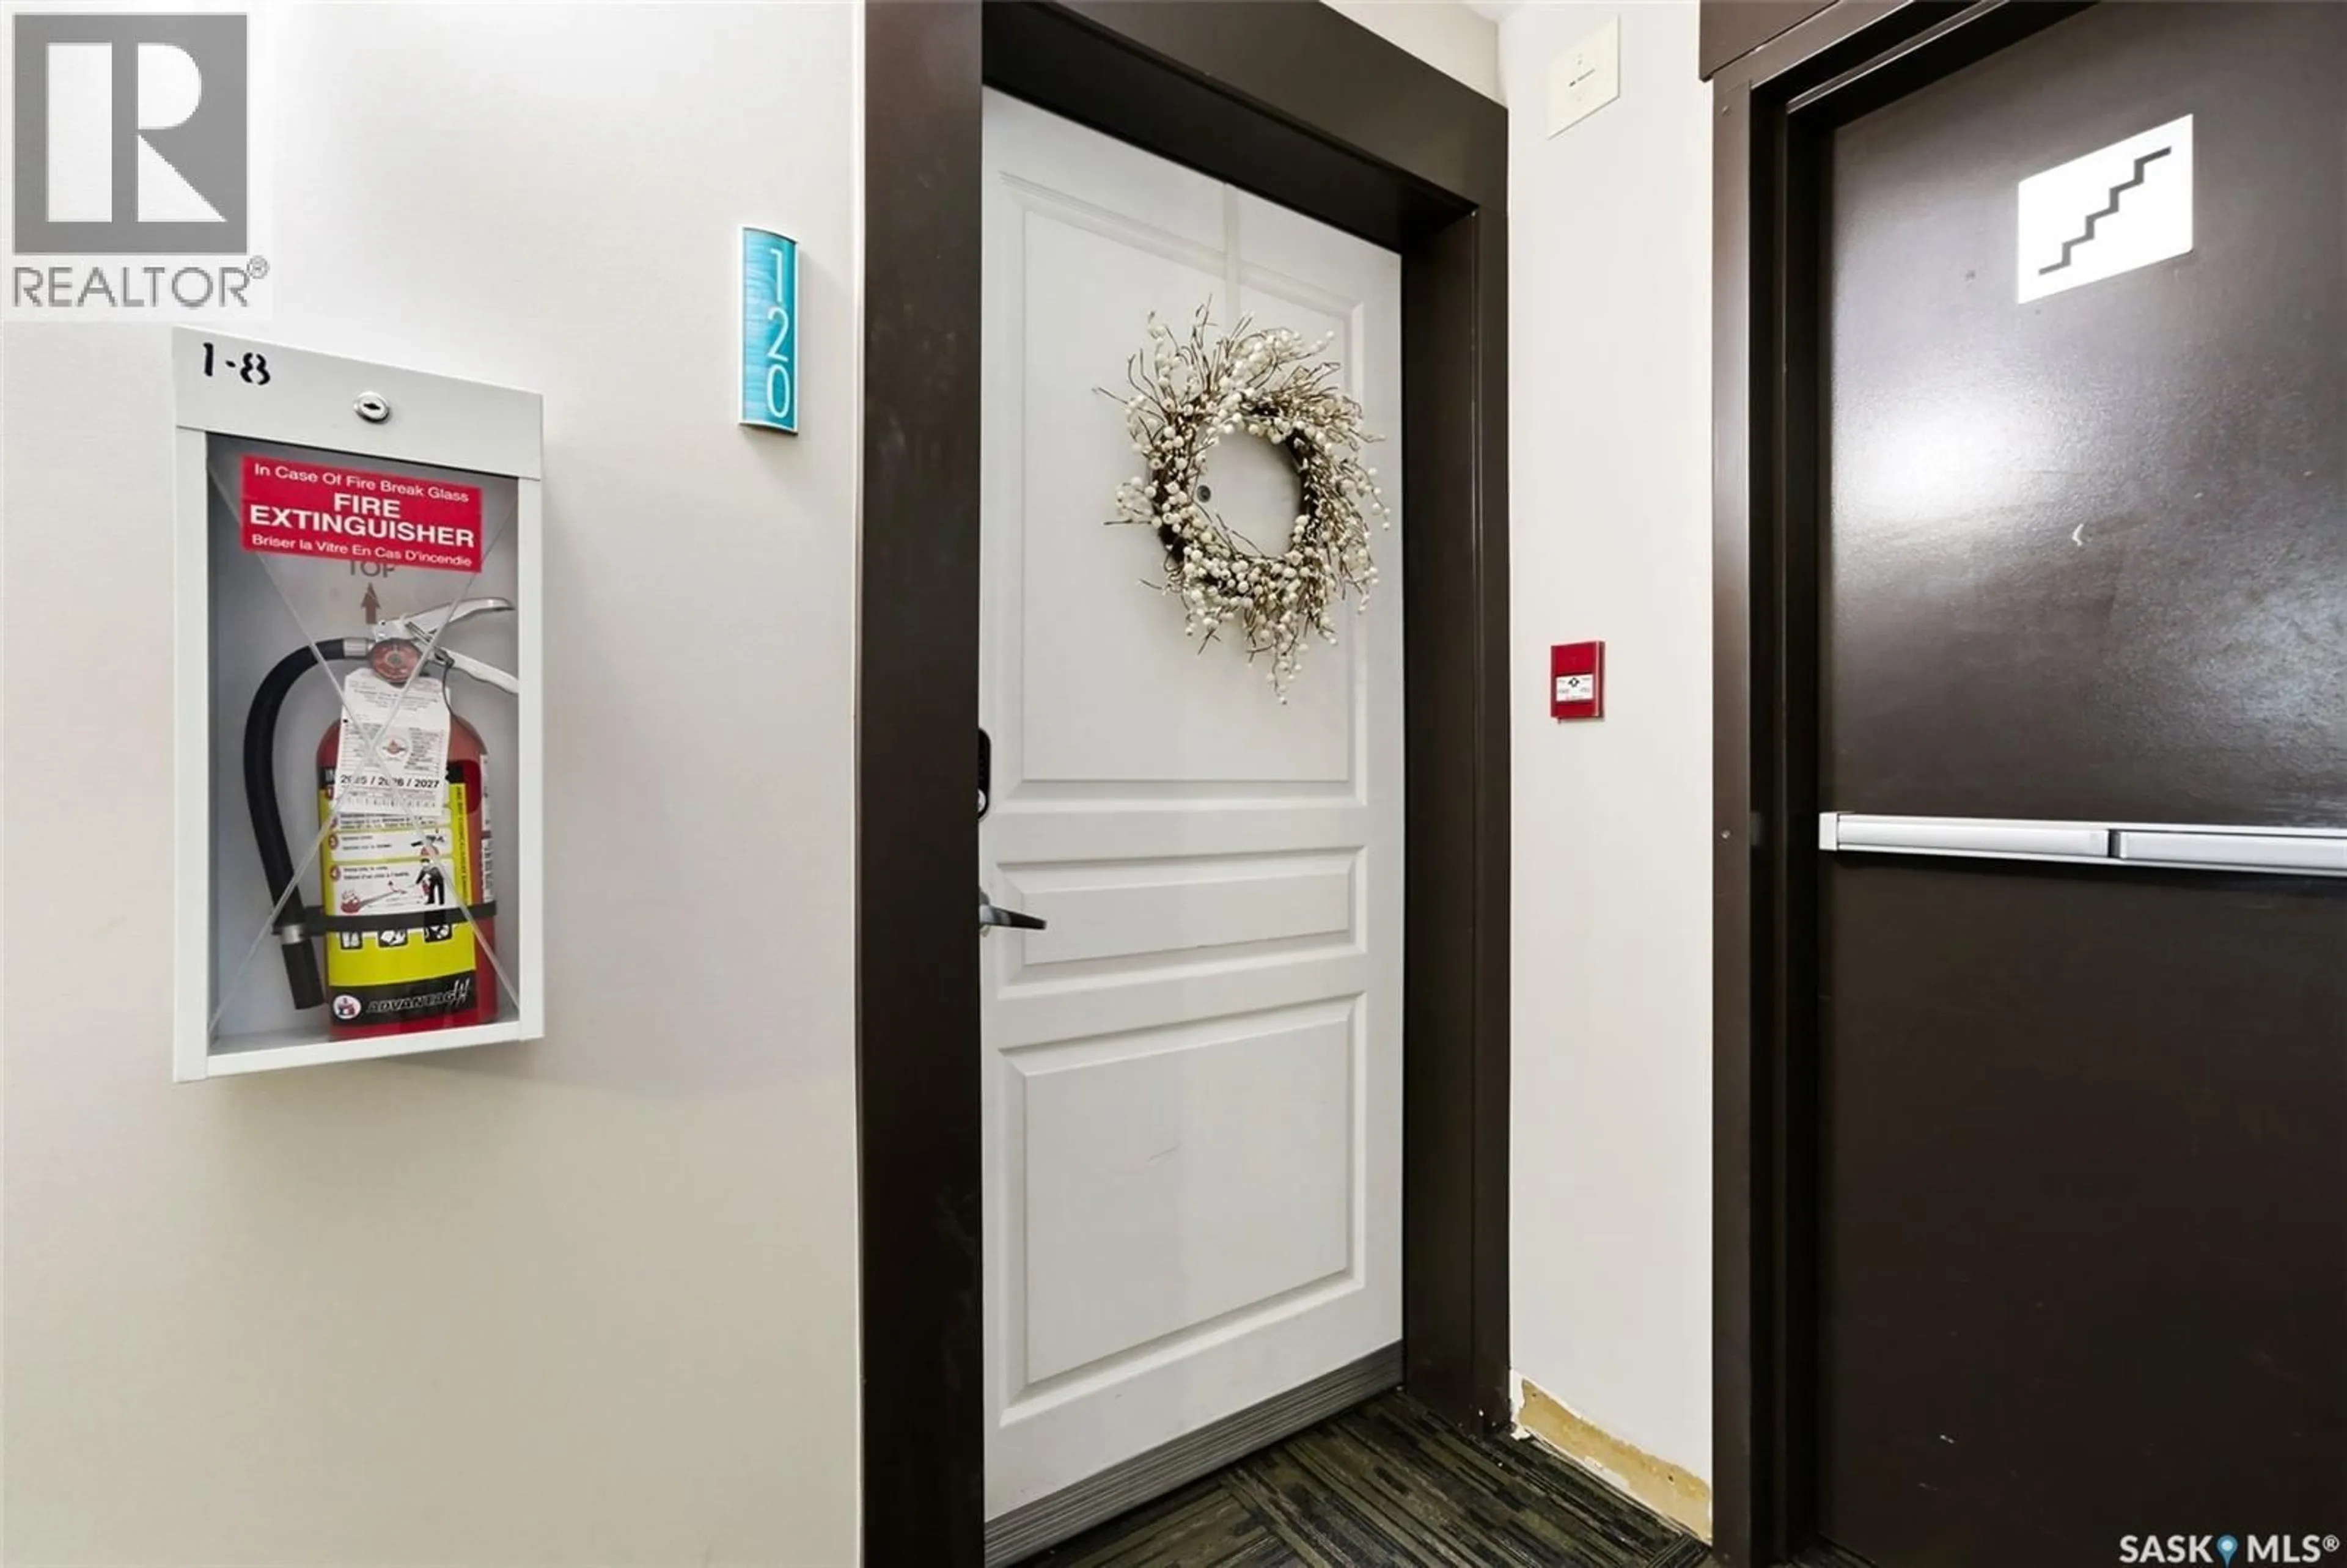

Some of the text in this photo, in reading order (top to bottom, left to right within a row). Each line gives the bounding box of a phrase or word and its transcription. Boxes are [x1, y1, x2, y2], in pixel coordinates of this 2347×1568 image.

[766, 247, 790, 418] 120
[202, 341, 271, 386] 1-8
[254, 463, 470, 504] In Case Of Fire Break Glass
[334, 492, 401, 519] FIRE
[249, 504, 475, 549] EXTINGUISHER
[252, 533, 472, 567] Briser la Vitre En Cas D'incendie
[414, 779, 439, 788] 2027
